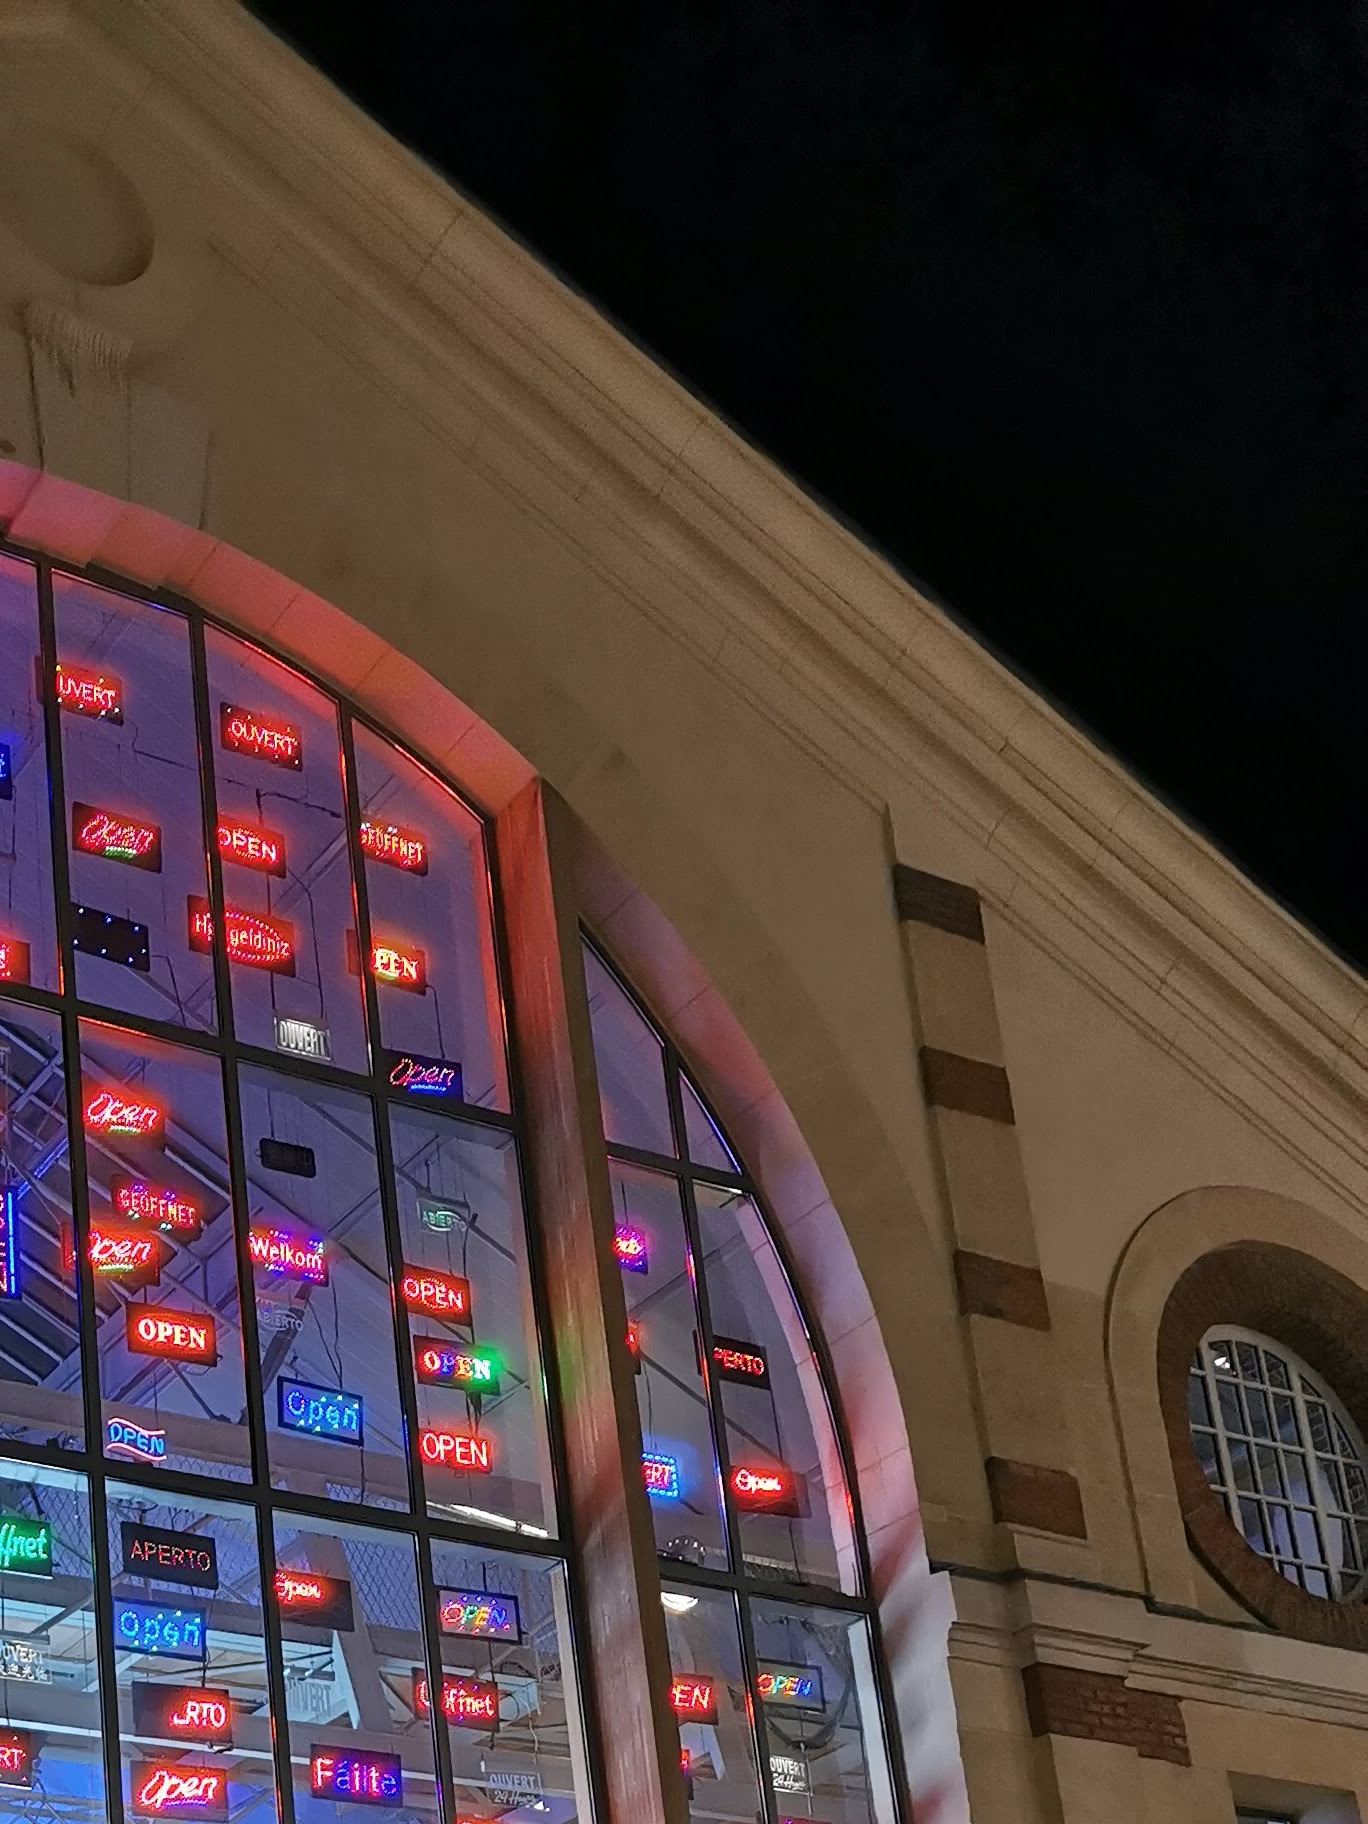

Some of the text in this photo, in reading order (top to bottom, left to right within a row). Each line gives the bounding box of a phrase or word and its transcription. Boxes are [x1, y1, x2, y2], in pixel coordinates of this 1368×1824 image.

[59, 671, 116, 708] UVERT
[230, 720, 296, 756] OUVERT
[82, 812, 155, 853] Open
[218, 826, 277, 863] OPEN
[373, 946, 419, 980] PEN
[389, 1057, 455, 1088] Open
[87, 1089, 161, 1128] Open
[249, 1232, 323, 1271] Welkom
[403, 1276, 464, 1310] OPEN
[138, 1318, 207, 1352] OPEN
[423, 1350, 491, 1381] OPEN
[109, 1422, 165, 1456] OPEN
[422, 1431, 488, 1467] OPEN
[130, 1539, 211, 1573] APERTO
[442, 1601, 508, 1627] OPEN
[756, 1672, 813, 1698] OPEN
[139, 1769, 218, 1809] Open
